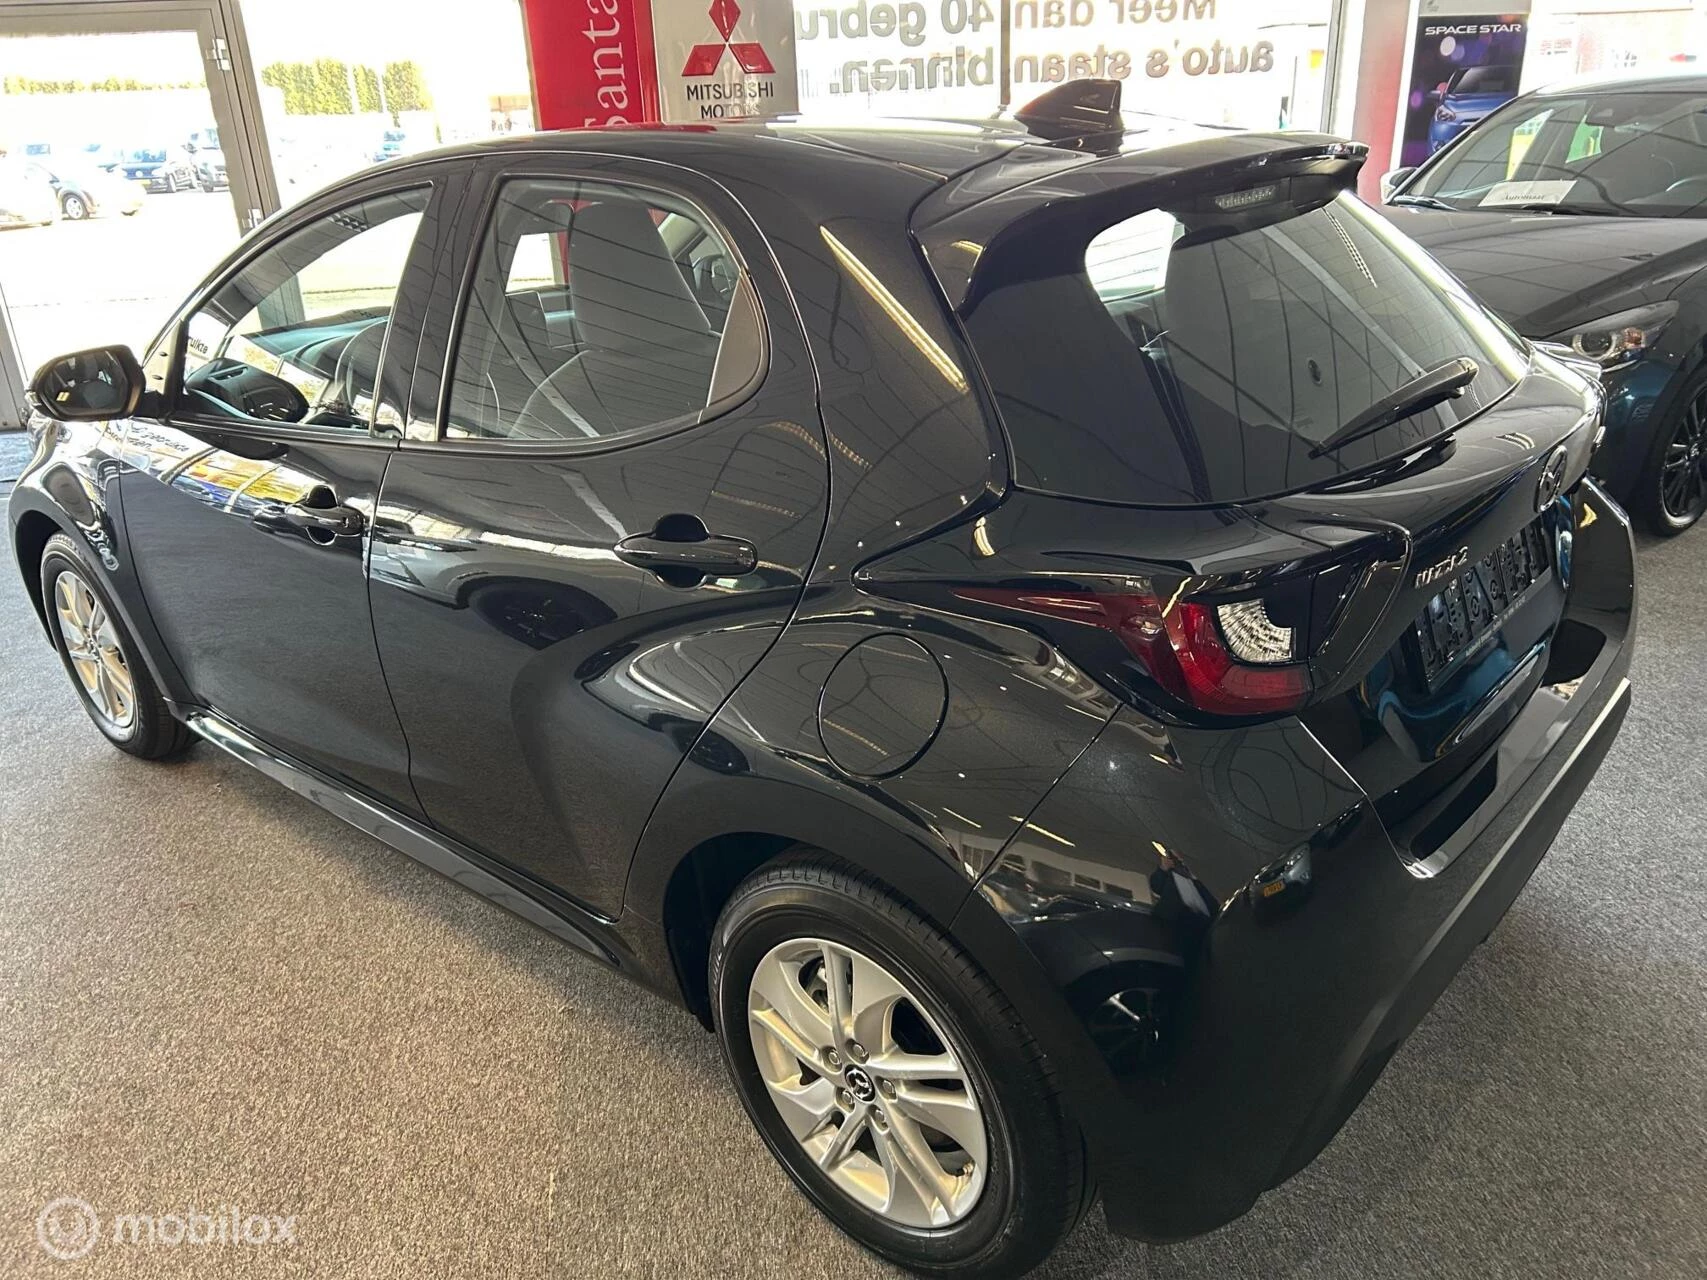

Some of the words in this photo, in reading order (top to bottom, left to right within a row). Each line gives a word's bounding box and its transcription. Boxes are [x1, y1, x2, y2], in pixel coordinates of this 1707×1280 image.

[1425, 25, 1478, 35] SPACE
[1479, 23, 1522, 33] STAR
[686, 82, 774, 101] MITSUBISHI
